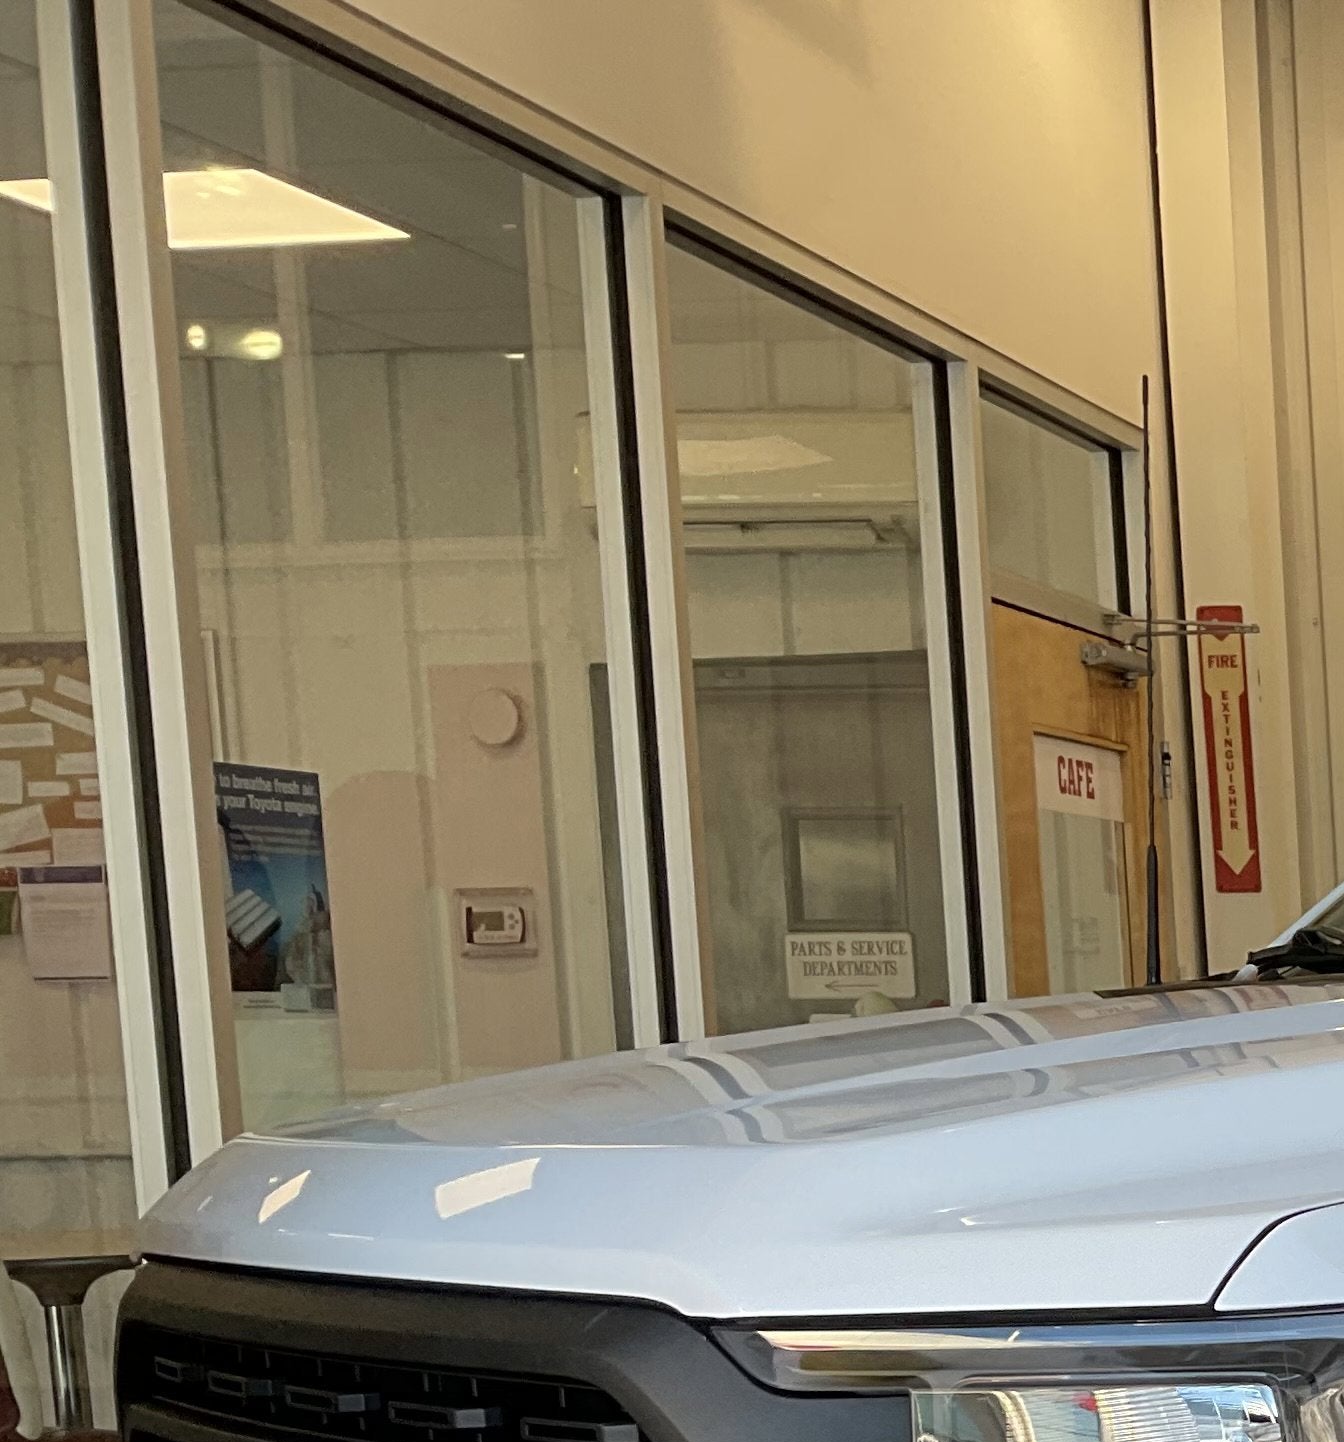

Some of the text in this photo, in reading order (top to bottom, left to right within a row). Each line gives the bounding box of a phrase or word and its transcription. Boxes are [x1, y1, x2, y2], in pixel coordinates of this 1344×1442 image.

[1207, 654, 1239, 669] FIRE
[1220, 690, 1241, 831] EXTINGUISHER
[1057, 755, 1095, 800] CAFE
[246, 793, 282, 814] Toyota
[791, 940, 908, 957] PARTS & SERVICE
[803, 960, 898, 977] DEPARTMENTS
